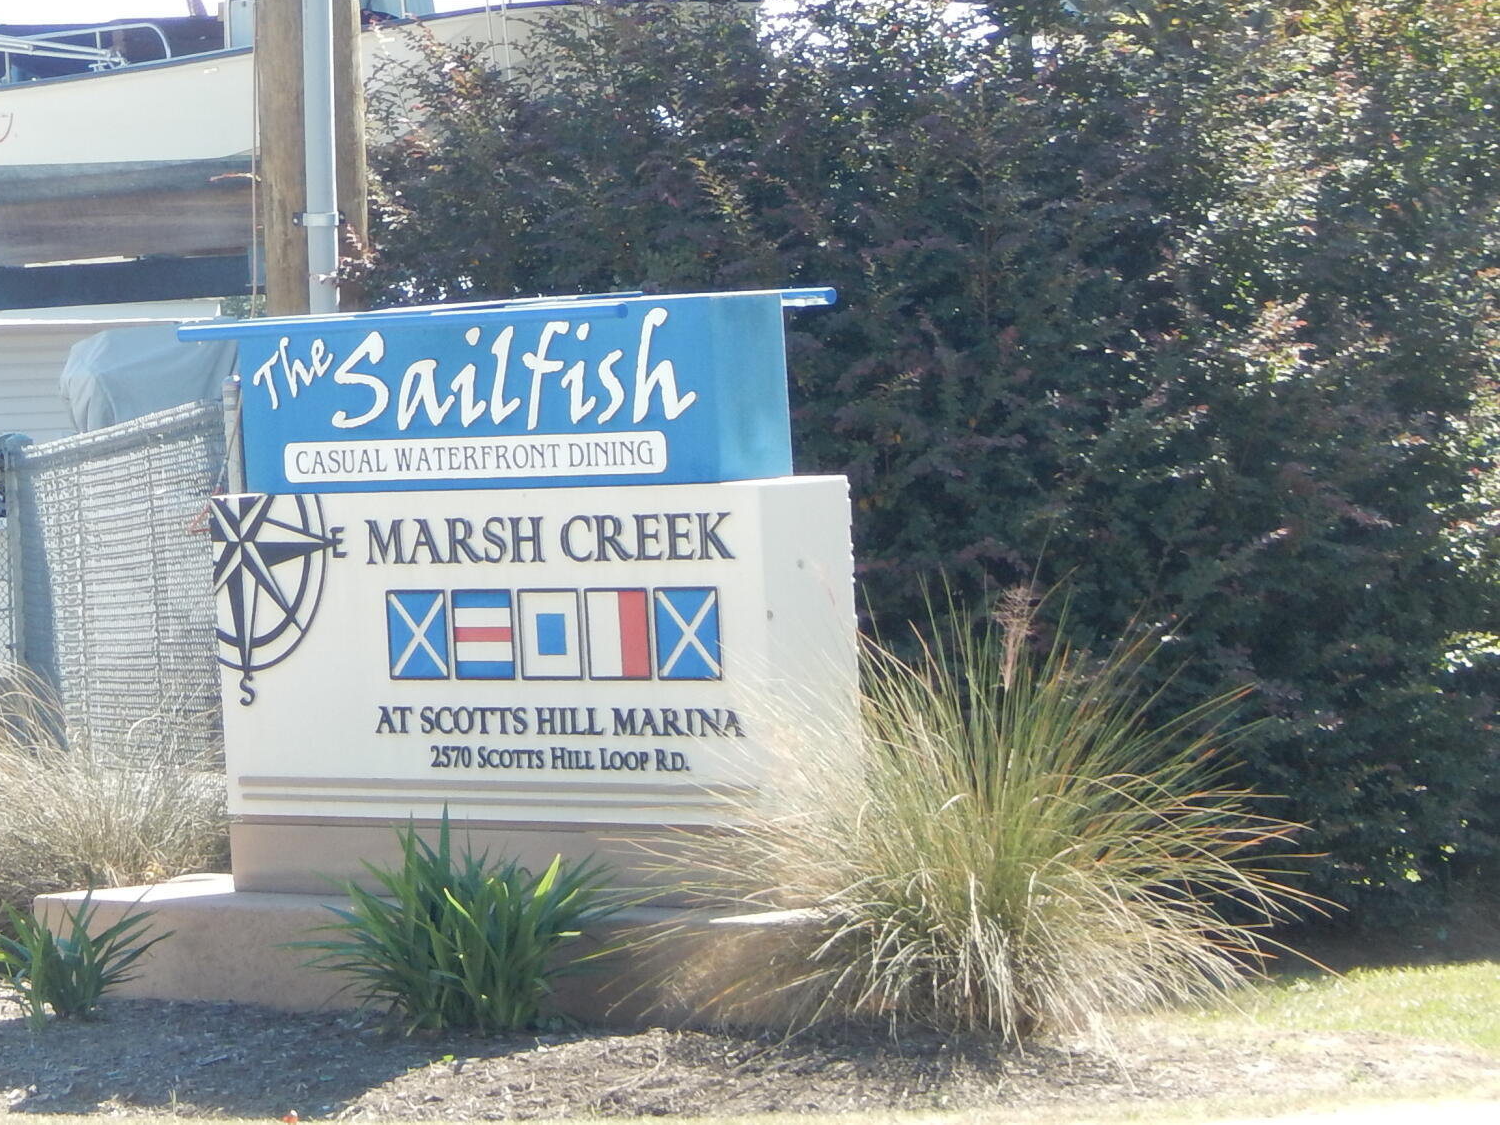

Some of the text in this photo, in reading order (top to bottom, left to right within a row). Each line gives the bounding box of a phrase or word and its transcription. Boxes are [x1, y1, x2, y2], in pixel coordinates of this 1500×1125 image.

[253, 306, 697, 432] The Sailfish
[295, 438, 655, 475] CASUAL WATERFRONT DINING
[329, 526, 347, 559] E
[364, 511, 736, 566] MARSH CREEK
[239, 674, 256, 706] S
[375, 705, 748, 738] AT SCOTTS HILL MARINA
[430, 744, 472, 769] 2570
[477, 745, 544, 770] SCOTTS
[550, 746, 596, 771] HILL
[600, 747, 649, 772] LOOP
